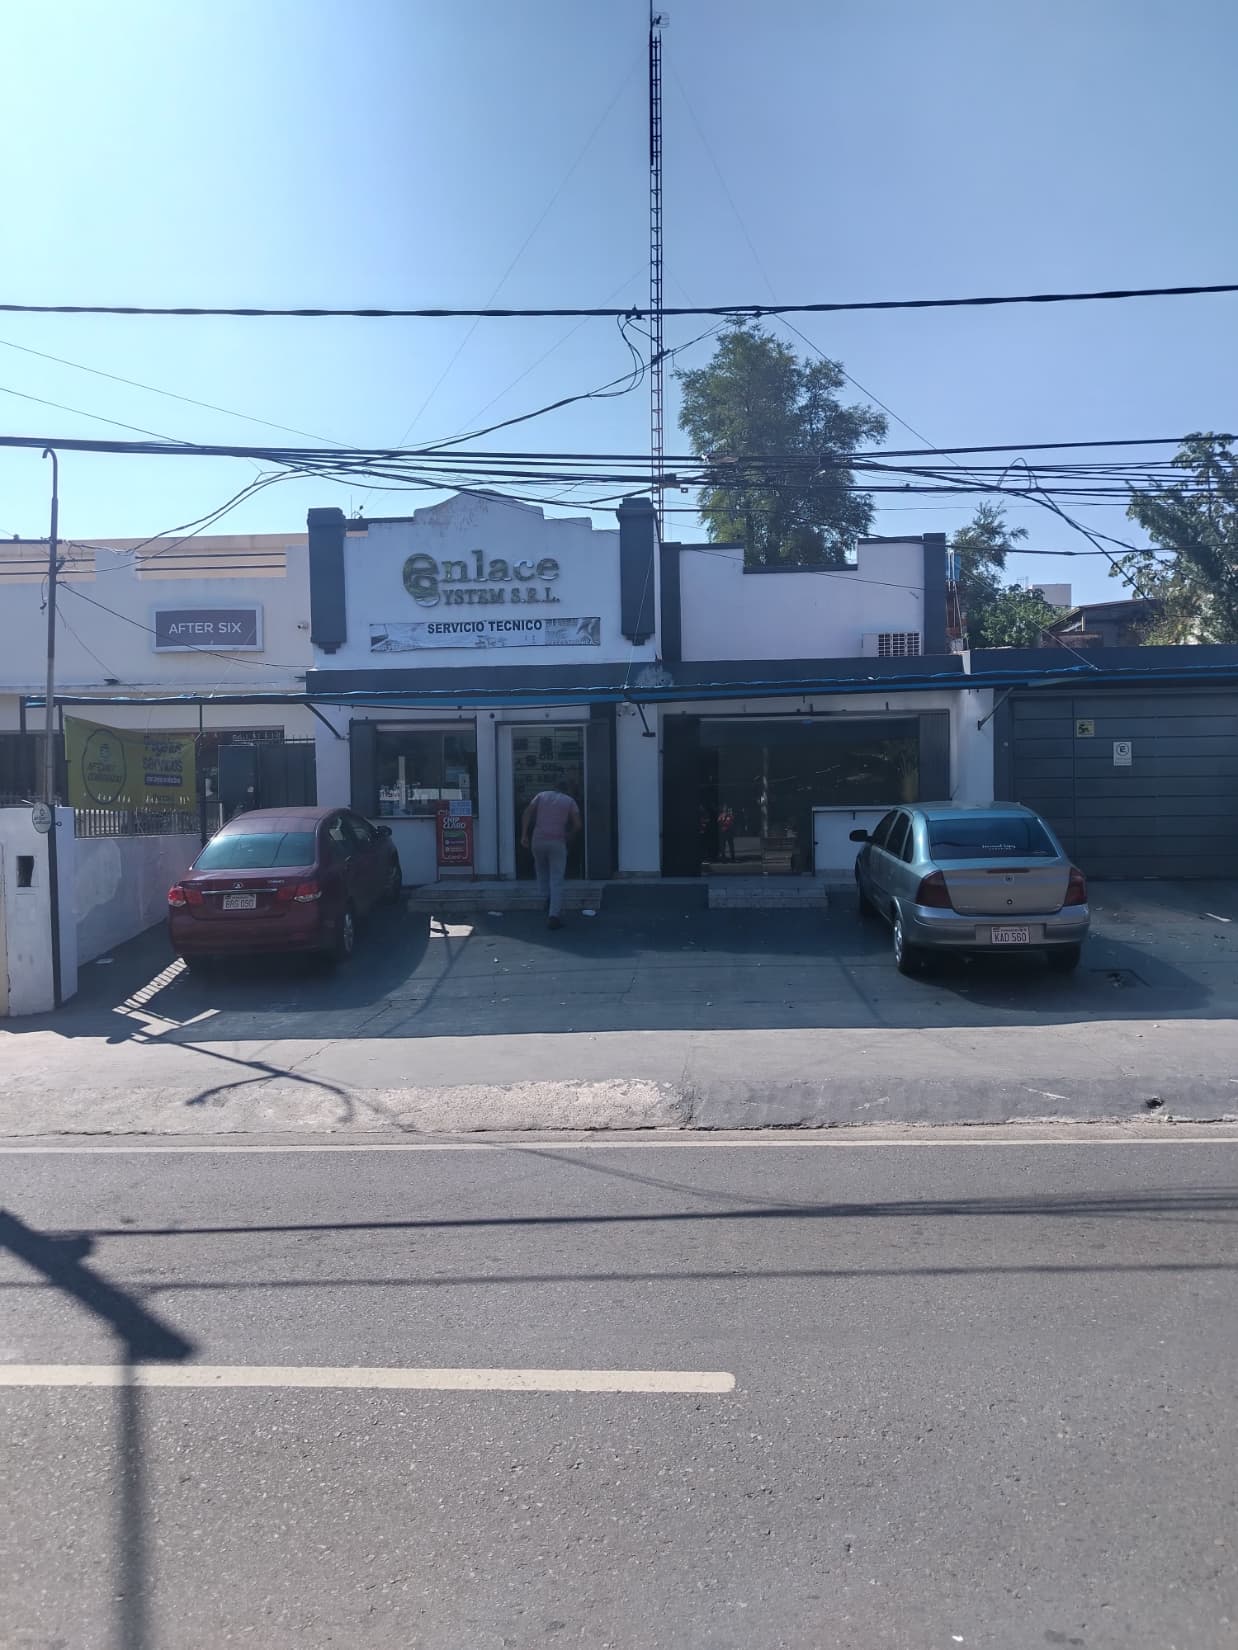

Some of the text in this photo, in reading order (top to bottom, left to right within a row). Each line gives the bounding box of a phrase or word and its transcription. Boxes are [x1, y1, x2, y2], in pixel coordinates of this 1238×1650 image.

[169, 622, 242, 635] AFTER SIX
[427, 621, 484, 634] SERVICIO
[488, 619, 542, 632] TECNICO
